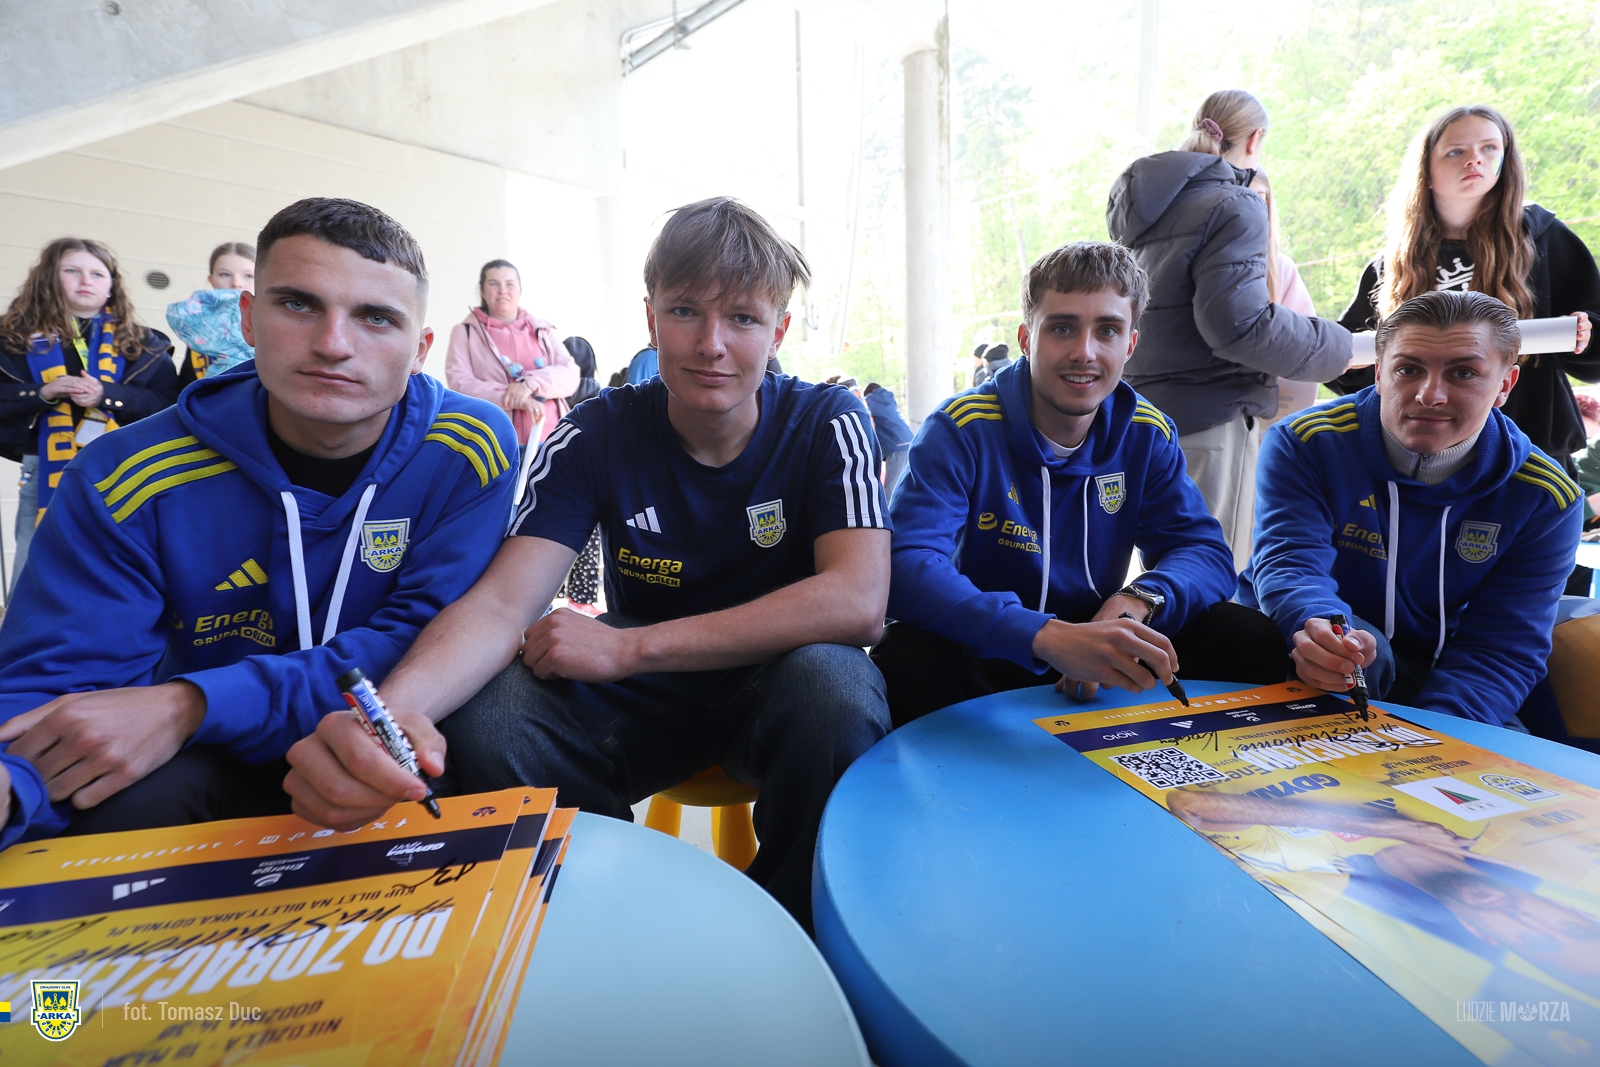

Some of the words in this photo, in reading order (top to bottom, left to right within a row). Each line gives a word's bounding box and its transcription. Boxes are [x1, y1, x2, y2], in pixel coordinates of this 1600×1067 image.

[1104, 493, 1122, 502] ARKA
[757, 525, 780, 535] ARKA
[998, 538, 1025, 551] GRUPA
[1338, 540, 1369, 554] GRUPA
[1461, 541, 1489, 551] ARKA
[371, 546, 402, 557] ARKA
[617, 548, 683, 575] Energa
[618, 566, 646, 581] GRUPA
[647, 574, 679, 587] ORLEN
[193, 629, 238, 647] GRUPA
[243, 628, 273, 646] ORLEN
[251, 861, 307, 877] Energa
[335, 890, 382, 906] BILET
[384, 886, 417, 899] KUP
[310, 897, 332, 910] NA
[362, 907, 453, 967] DO
